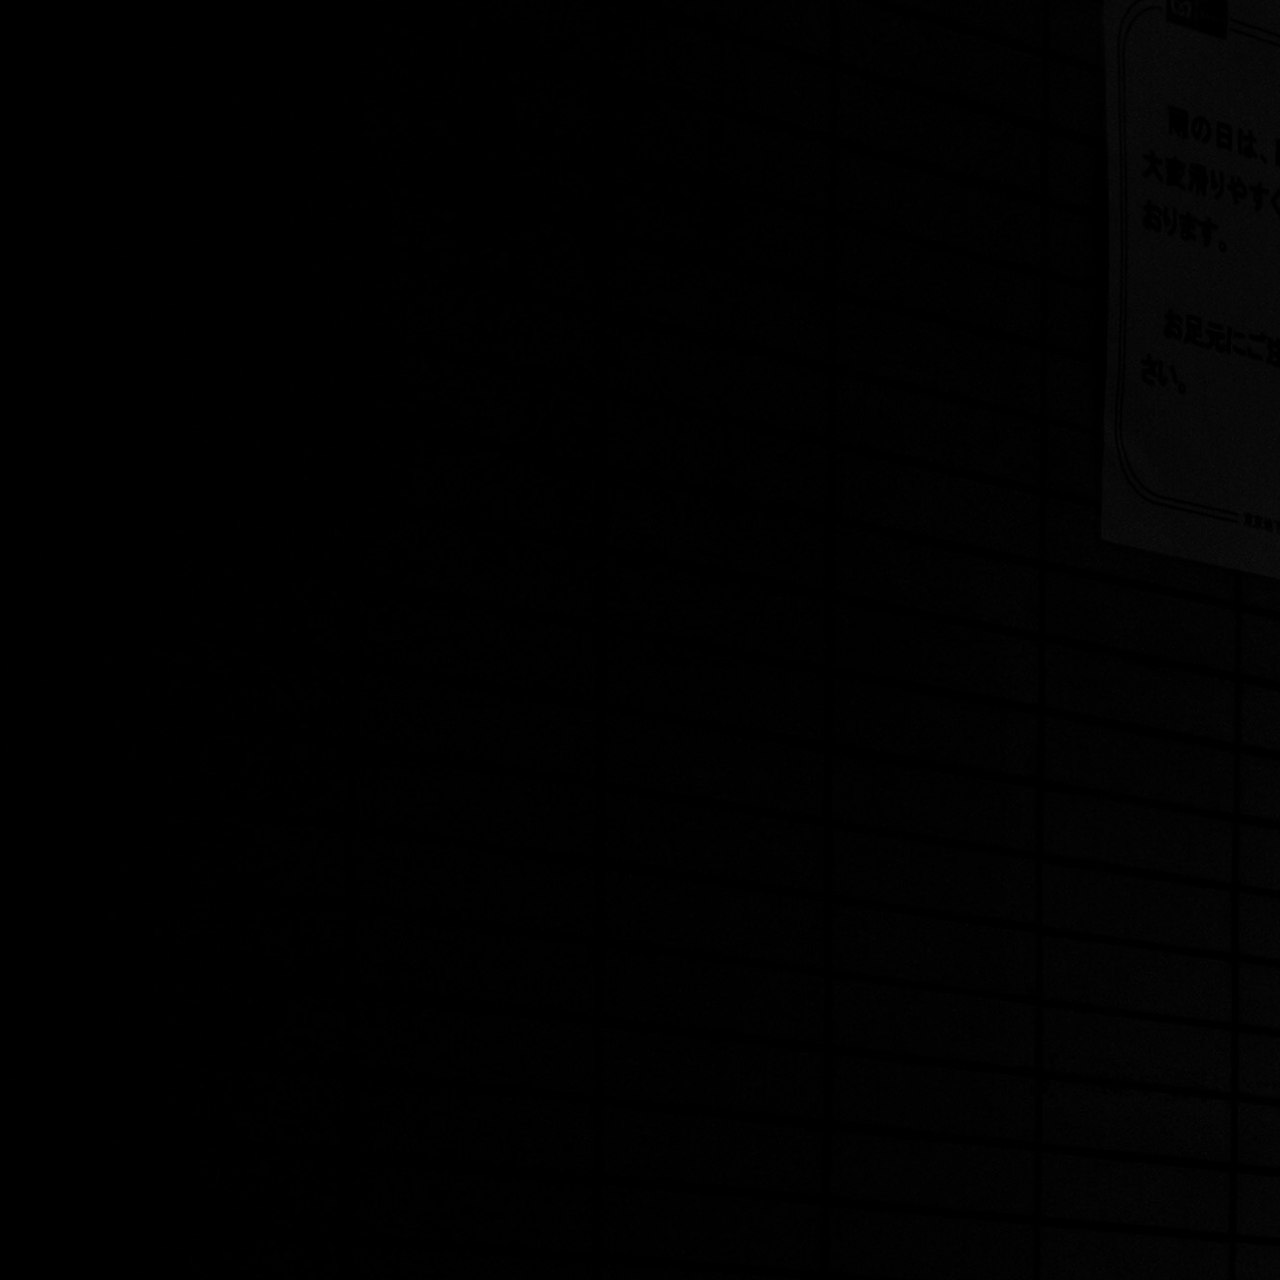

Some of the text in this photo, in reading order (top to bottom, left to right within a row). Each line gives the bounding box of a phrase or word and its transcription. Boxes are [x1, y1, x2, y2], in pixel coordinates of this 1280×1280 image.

[1141, 199, 1228, 253] おります。
[1140, 353, 1187, 395] さい。
